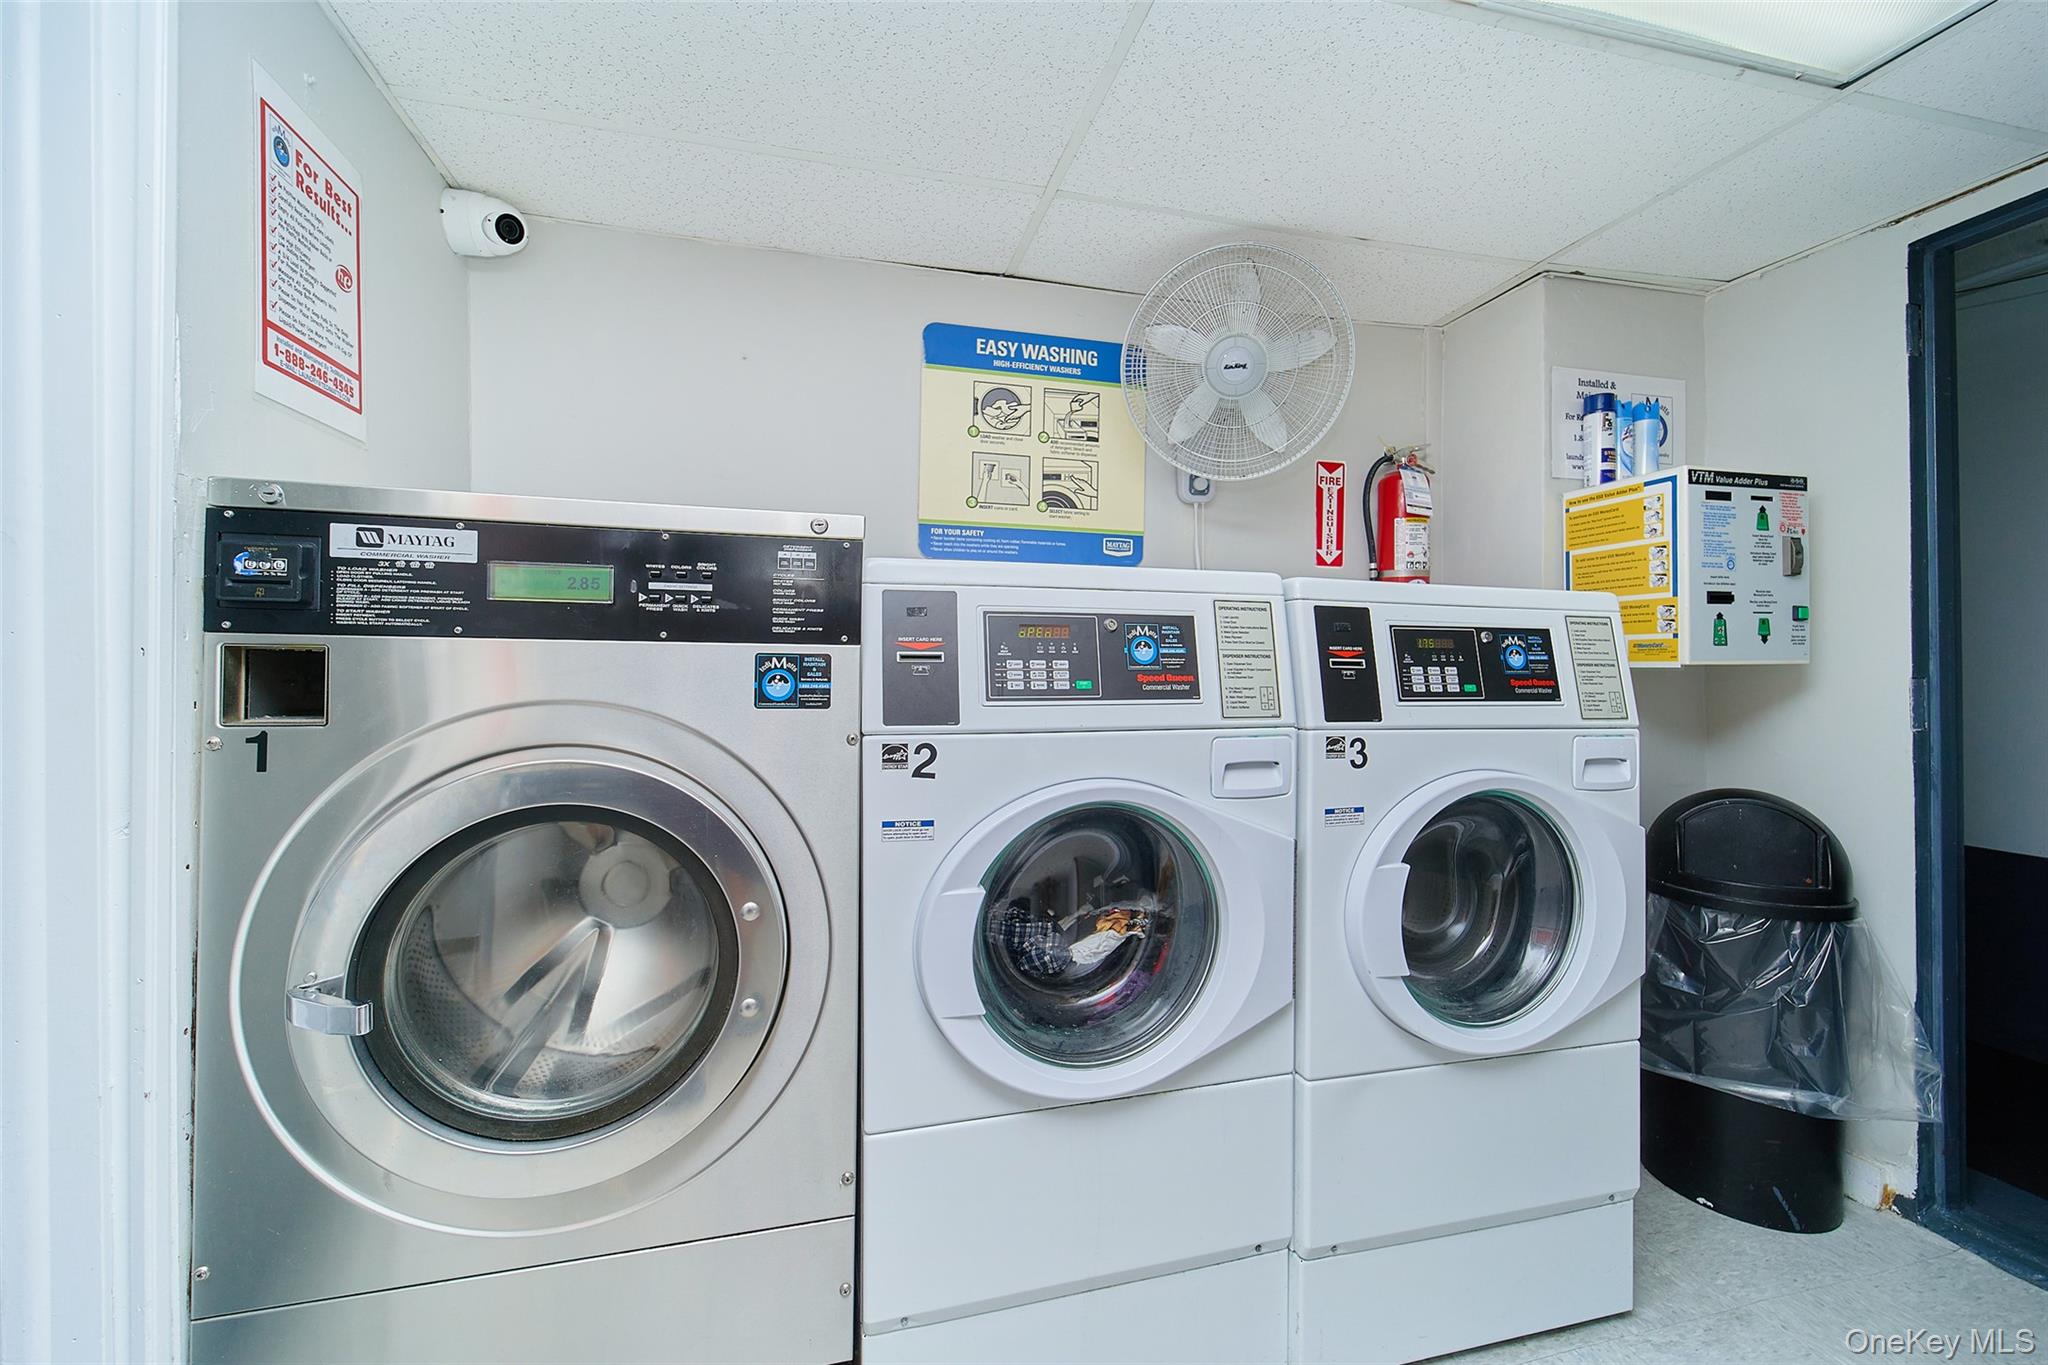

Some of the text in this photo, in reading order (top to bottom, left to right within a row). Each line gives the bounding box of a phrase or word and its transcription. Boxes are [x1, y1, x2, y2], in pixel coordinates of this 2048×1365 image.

[295, 149, 352, 218] For Best
[296, 170, 352, 236] Results...
[976, 338, 1098, 366] EASY WASHING
[274, 343, 354, 398] 1-888-246-4545
[993, 360, 1081, 375] HIGH-EFFICIENCY WASHERS
[1578, 378, 1616, 390] Installed &
[1565, 413, 1575, 421] For
[1320, 476, 1341, 486] FIRE
[1691, 471, 1714, 483] VTM
[1734, 477, 1753, 485] Adder
[1754, 478, 1768, 486] Plus
[1326, 487, 1334, 556] EXTINGUISHER
[387, 533, 455, 547] MAYTAG
[961, 529, 985, 537] SAFETY
[360, 551, 413, 559] COMMERCIAL
[567, 577, 601, 591] 2.85
[1137, 674, 1194, 683] Speed Queen
[1510, 679, 1532, 687] Speed
[245, 731, 268, 772] 1
[1350, 737, 1368, 769] 3
[912, 743, 937, 779] 2
